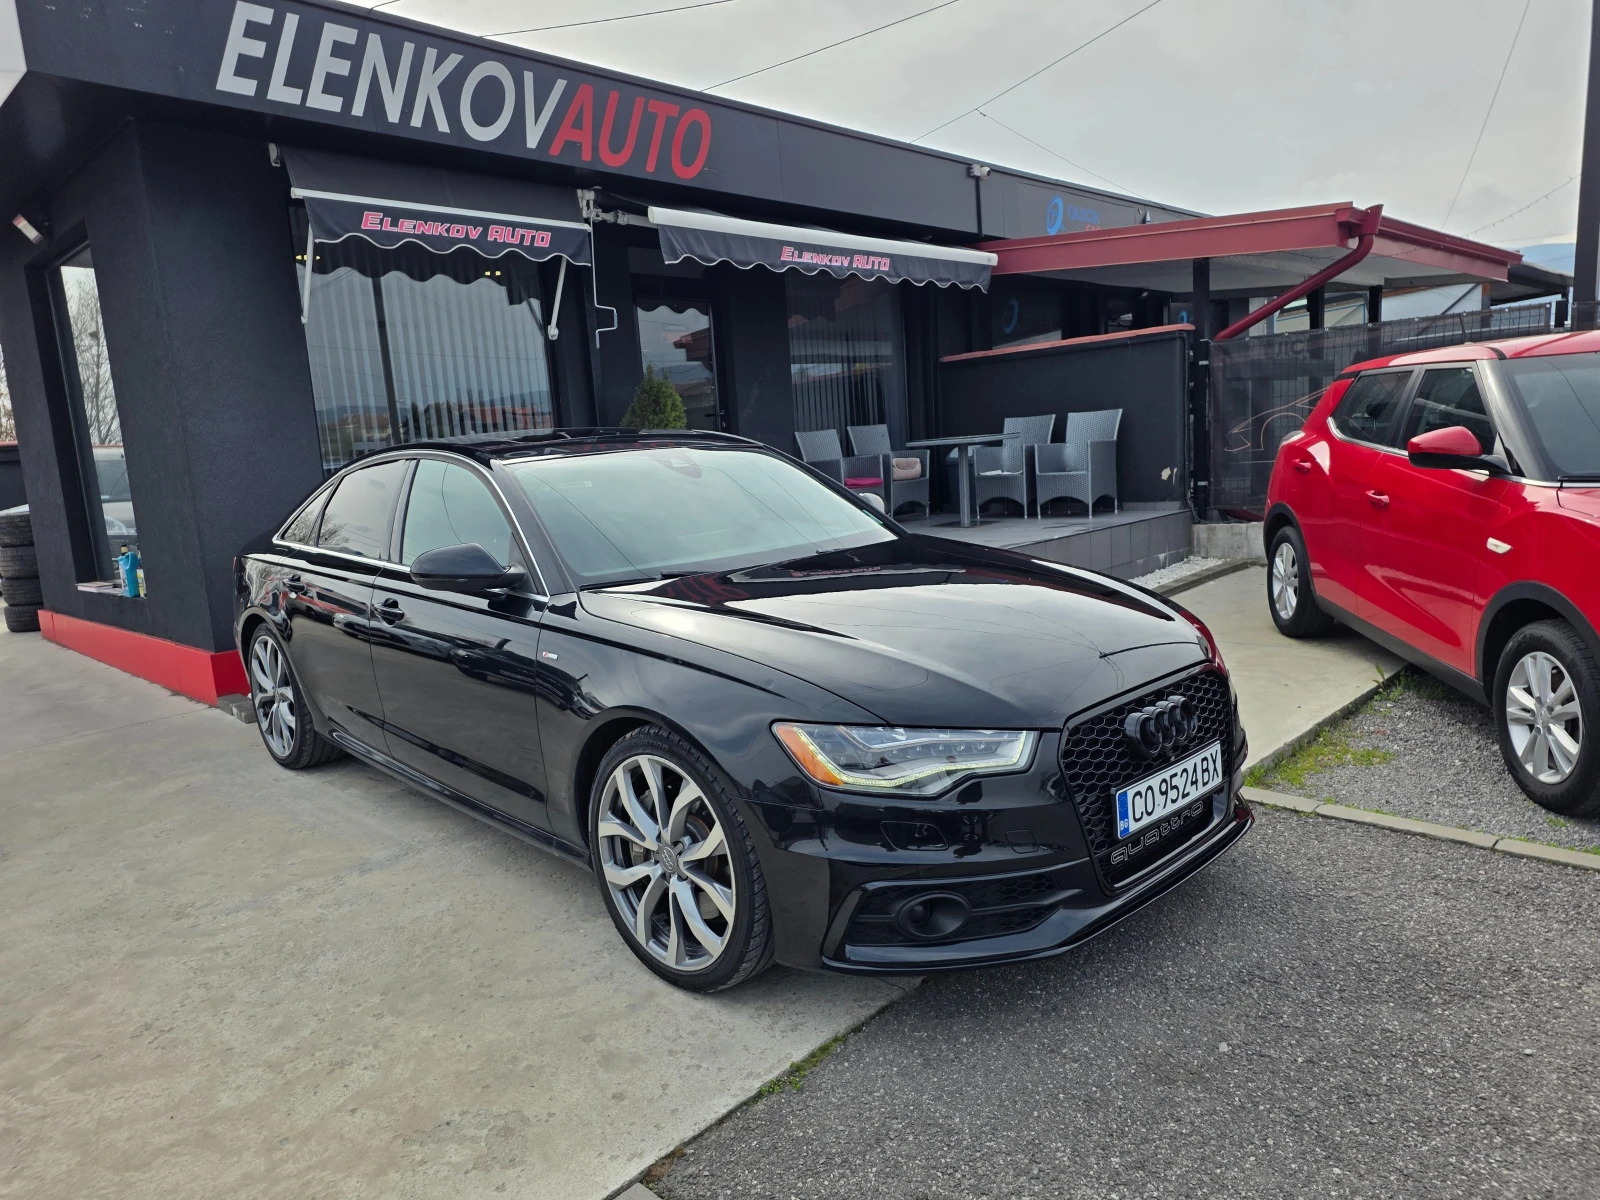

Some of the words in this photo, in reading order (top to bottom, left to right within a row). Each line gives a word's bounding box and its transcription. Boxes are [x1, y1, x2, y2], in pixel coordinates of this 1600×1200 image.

[1067, 205, 1100, 224] QUICK
[361, 211, 483, 240] ELENKOV
[487, 225, 552, 248] AUTO
[780, 246, 851, 267] ELENKOV
[853, 253, 890, 271] AUTO
[1110, 801, 1204, 865] quattro
[1119, 820, 1129, 830] BG
